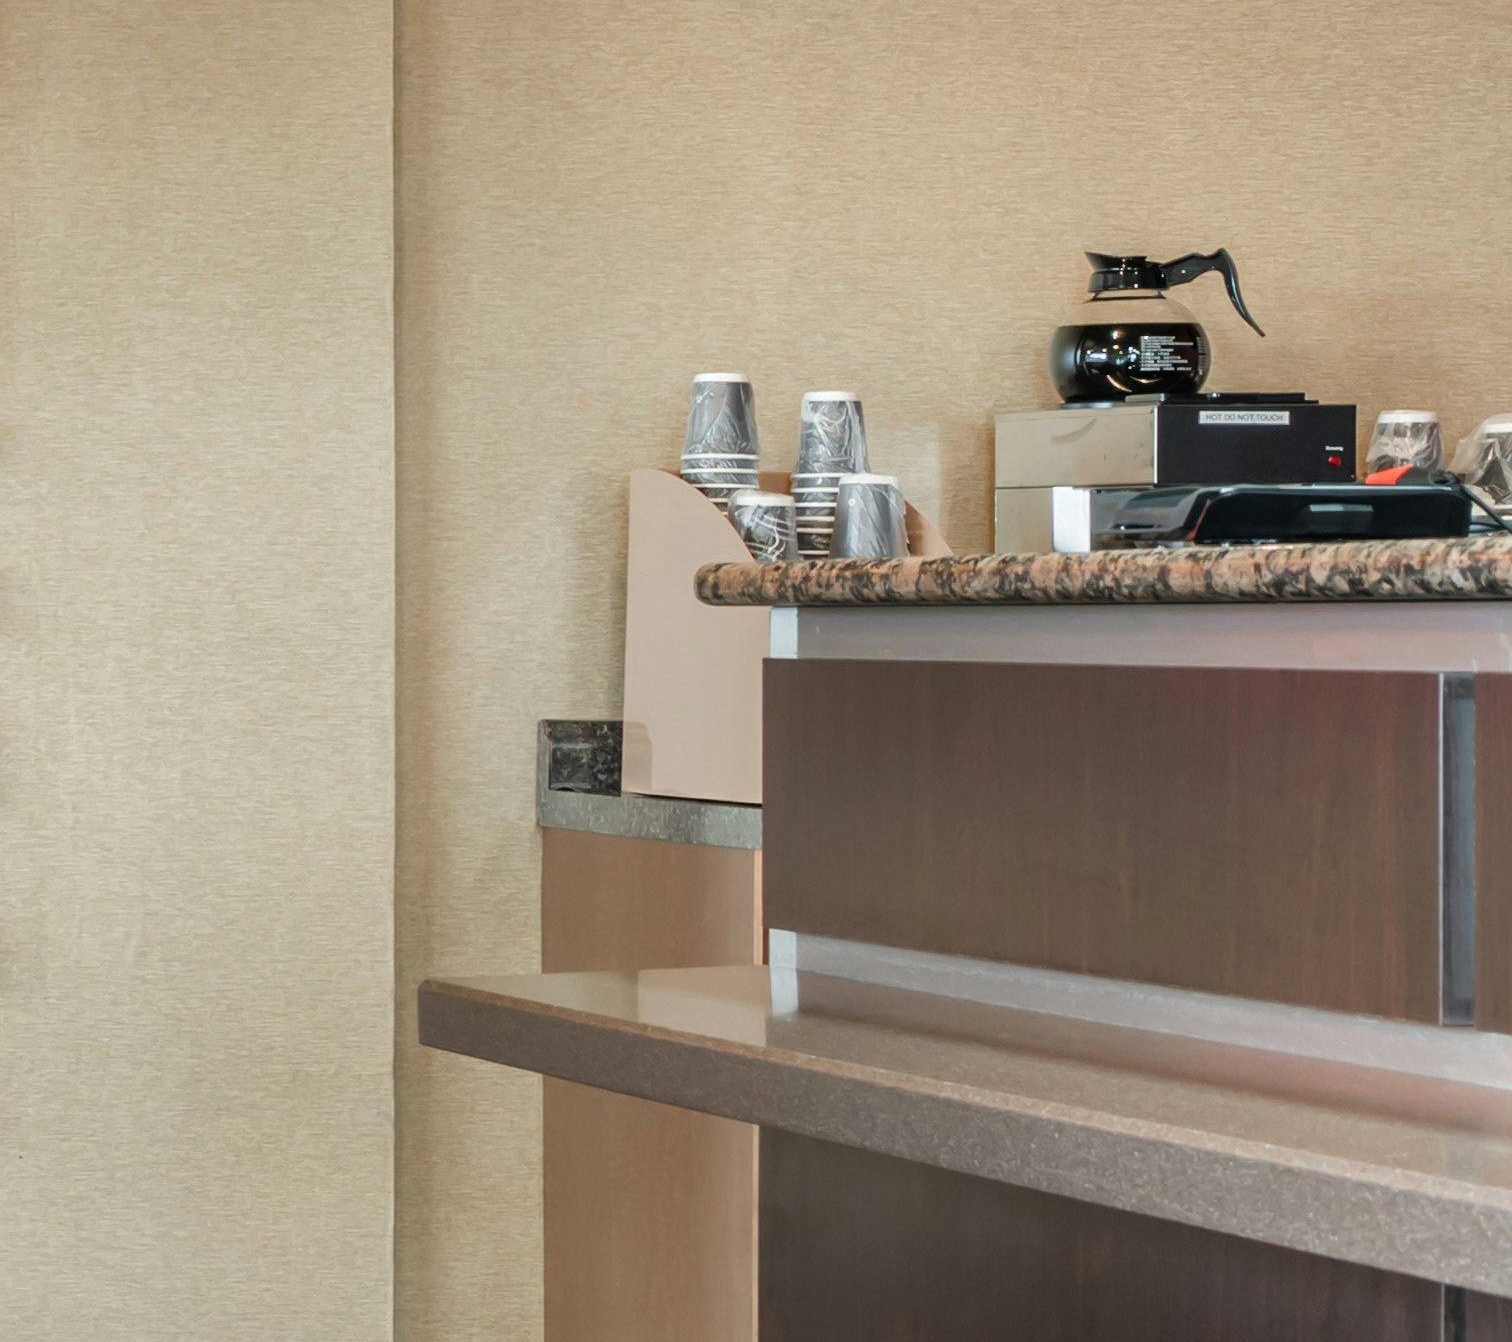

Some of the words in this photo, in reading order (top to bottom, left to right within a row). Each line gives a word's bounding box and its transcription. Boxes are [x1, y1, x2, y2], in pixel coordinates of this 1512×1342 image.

[1205, 413, 1222, 421] HOT
[1224, 413, 1236, 421] DO
[1237, 413, 1255, 422] NOT
